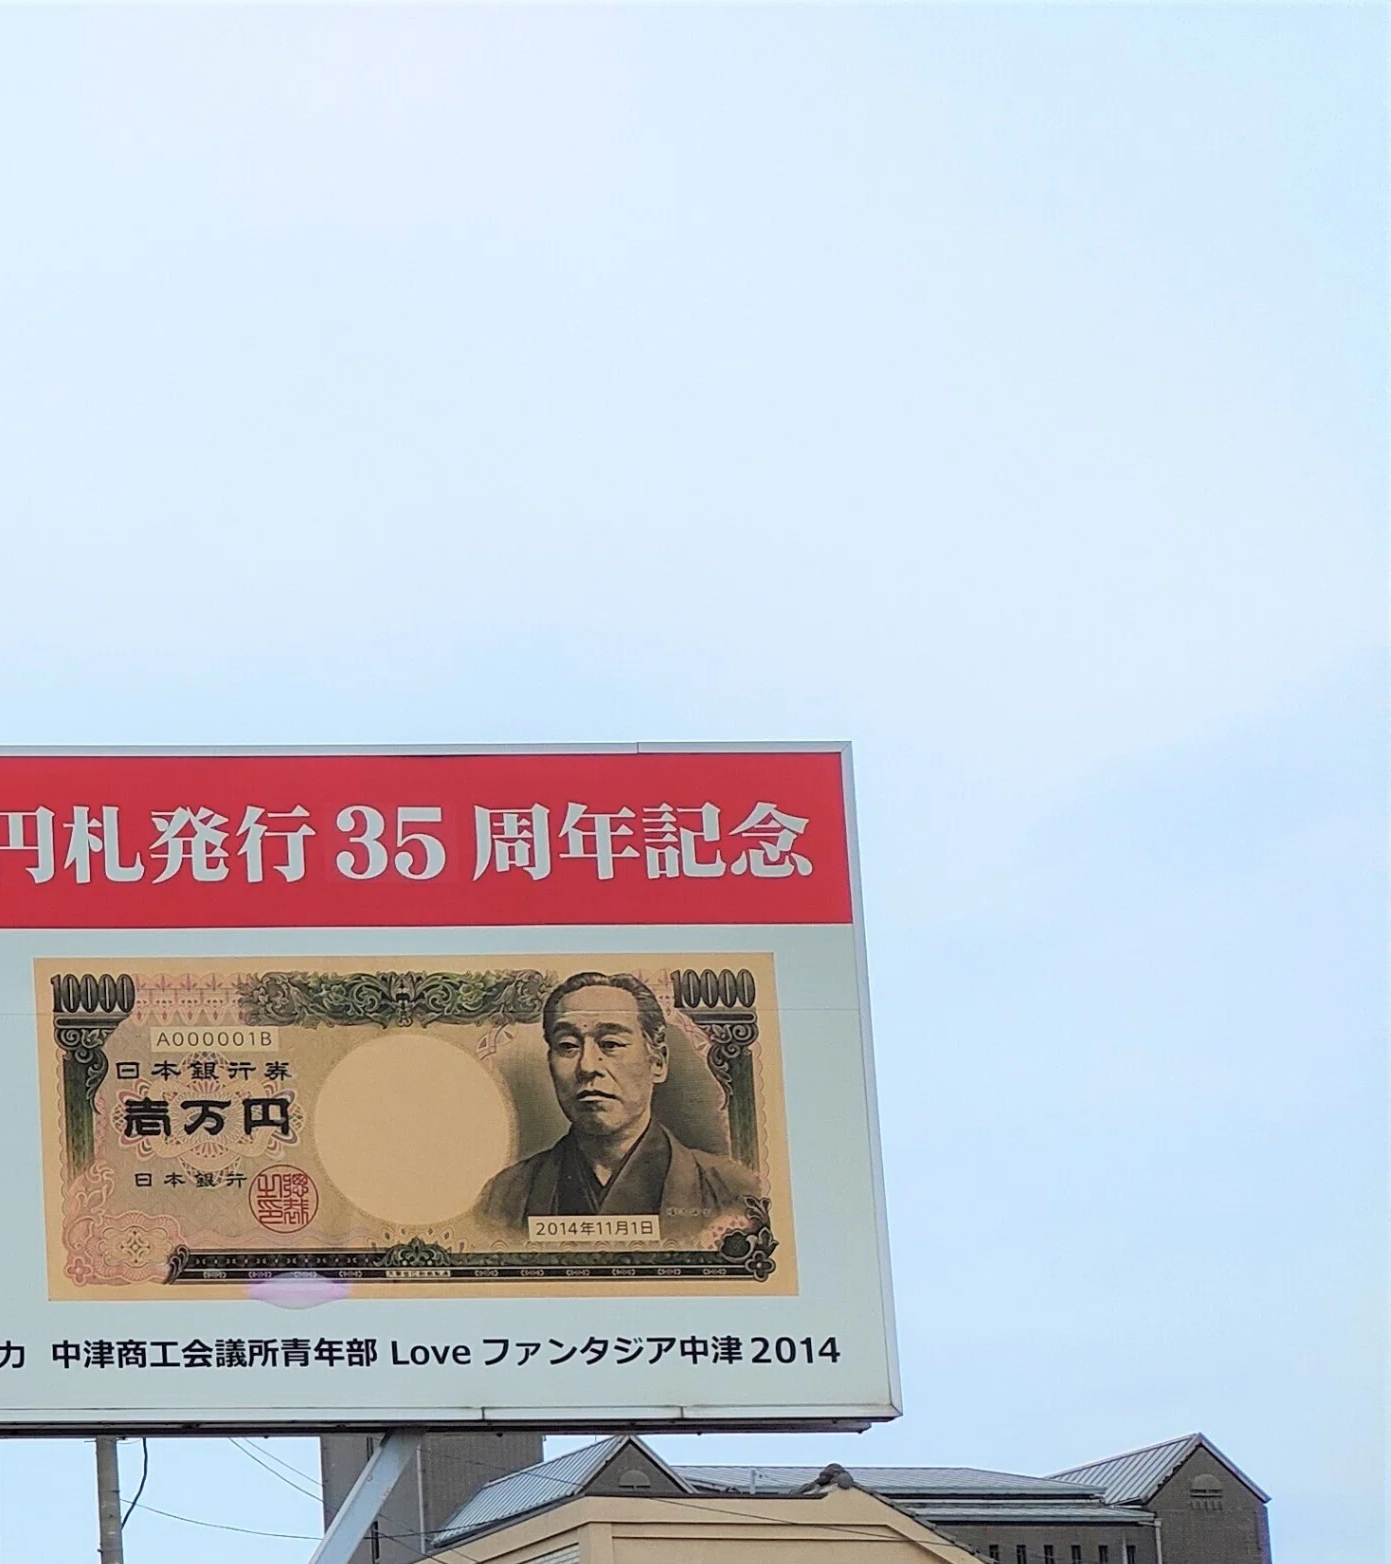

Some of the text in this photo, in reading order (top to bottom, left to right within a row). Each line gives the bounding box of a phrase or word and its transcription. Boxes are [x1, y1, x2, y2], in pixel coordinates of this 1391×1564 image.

[50, 973, 136, 1014] 10000
[671, 968, 757, 1009] 10000
[156, 1031, 273, 1047] A000001B
[115, 1060, 293, 1081] 日本銀行券
[123, 1098, 291, 1137] 壱万円
[133, 1172, 248, 1189] 日本銀行
[535, 1219, 654, 1238] 2014年11月1日
[50, 1337, 378, 1368] 中津商工会議所青年部
[390, 1338, 471, 1367] Love
